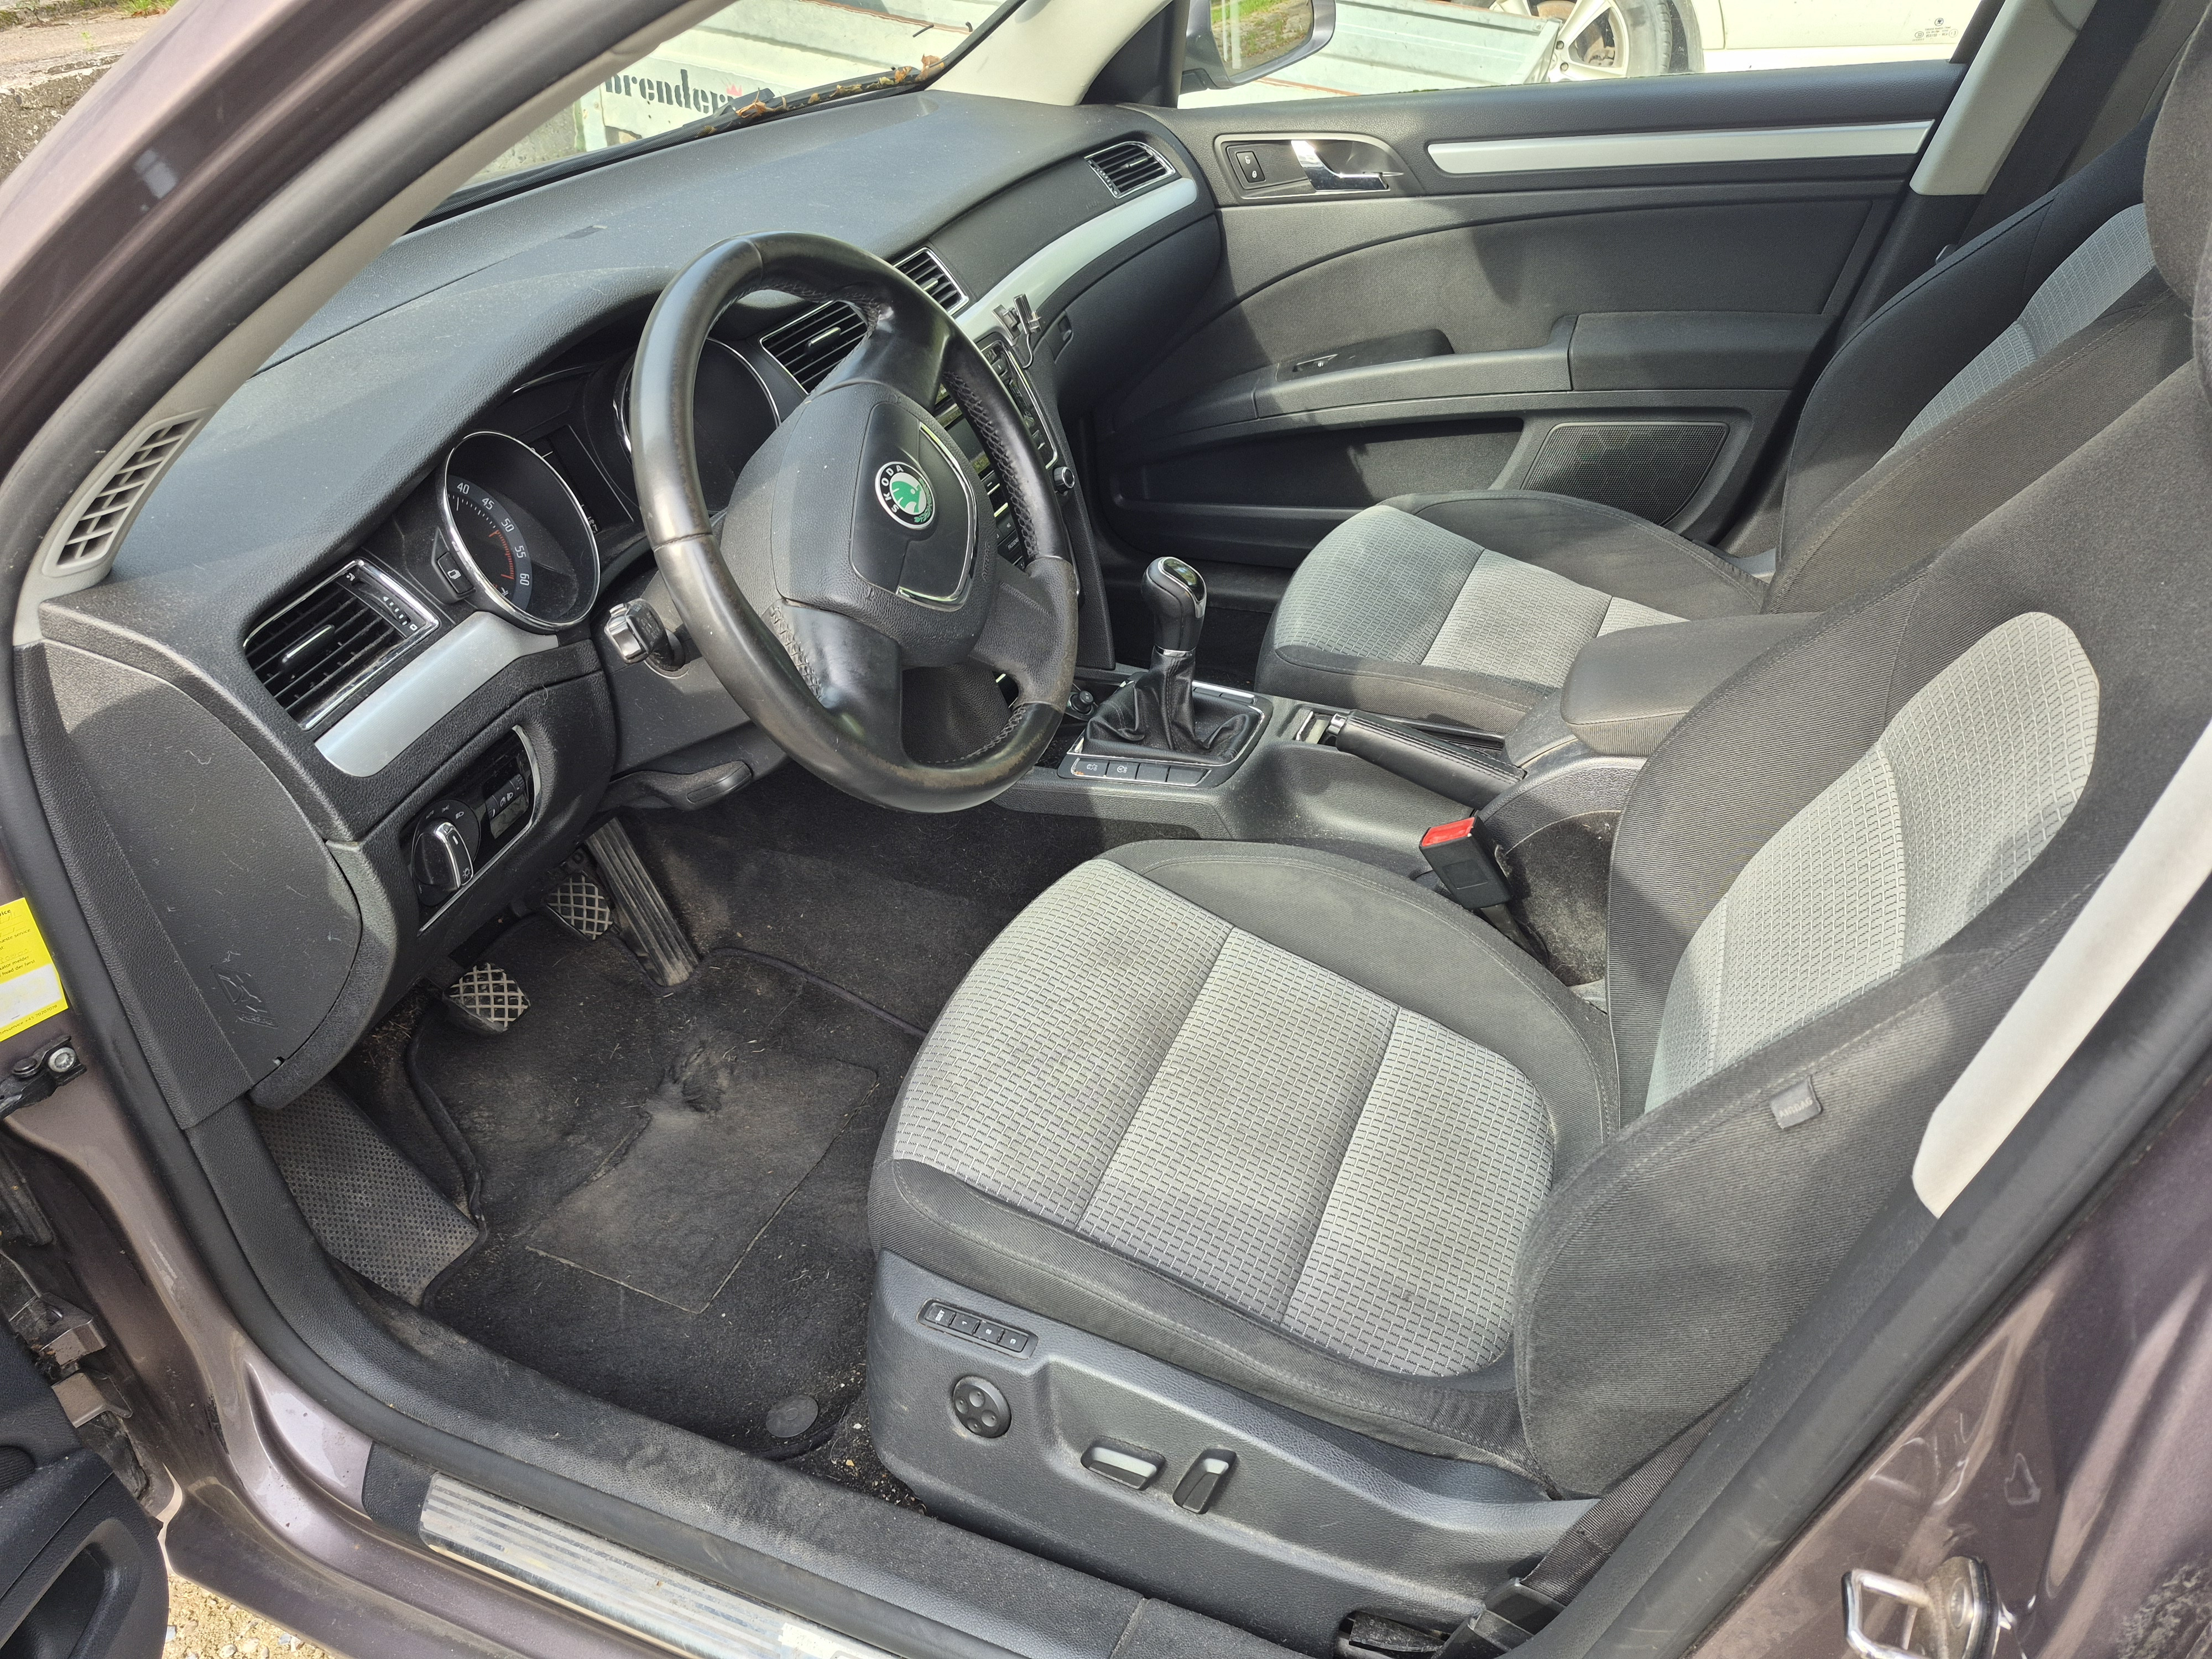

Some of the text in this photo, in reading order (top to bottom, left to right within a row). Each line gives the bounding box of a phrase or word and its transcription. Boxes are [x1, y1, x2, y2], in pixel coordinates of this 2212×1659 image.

[457, 482, 469, 494] 40
[482, 497, 495, 510] 45
[500, 518, 515, 533] 50
[515, 545, 526, 559] 55
[982, 541, 991, 582] AIRBAG
[520, 573, 530, 586] 60
[14, 929, 31, 938] service
[12, 956, 29, 965] melder
[1778, 1097, 1813, 1118] AIRBAG
